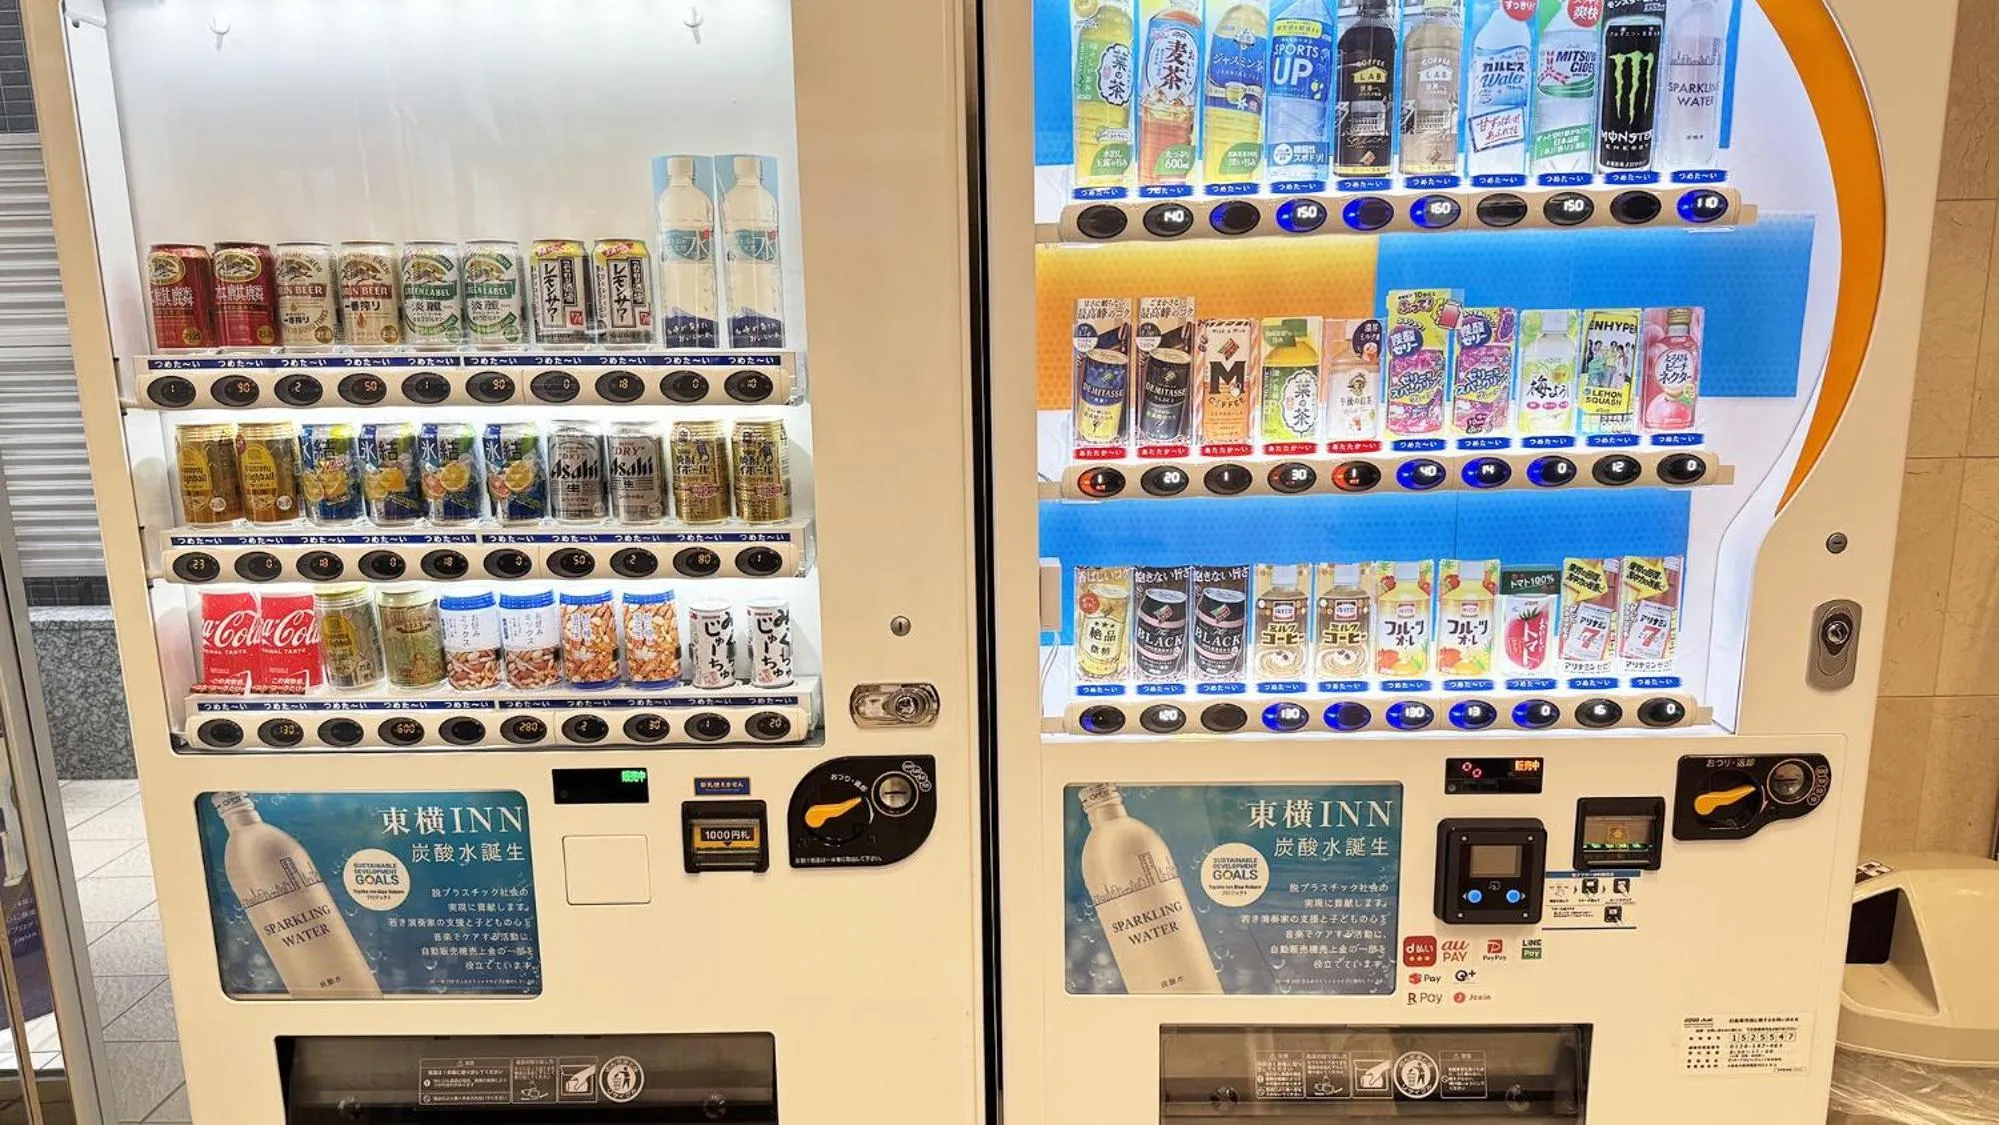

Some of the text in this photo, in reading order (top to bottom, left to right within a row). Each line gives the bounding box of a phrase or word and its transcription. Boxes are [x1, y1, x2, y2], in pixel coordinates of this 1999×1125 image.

[1573, 6, 1598, 20] 爽快
[1274, 43, 1319, 58] SPORTS
[1160, 40, 1187, 90] 麦茶
[1213, 53, 1264, 72] ジャスミン茶
[1482, 62, 1525, 73] カルピス
[1108, 50, 1127, 99] 葉の茶
[1273, 57, 1313, 86] UP
[1360, 72, 1382, 80] LAB
[1480, 72, 1525, 88] Water
[1164, 211, 1183, 222] 140
[363, 287, 388, 295] BEER
[544, 264, 560, 322] レモンサワー
[613, 264, 630, 322] レモンサワー
[345, 301, 381, 312] 一番搾り
[471, 300, 499, 310] 淡麗
[1078, 307, 1129, 319] 最高峰のコク
[1141, 307, 1193, 319] 最高峰のコク
[1666, 362, 1687, 372] ピーチ
[1210, 361, 1246, 394] M
[1659, 372, 1692, 384] ネクター
[365, 381, 377, 391] 50
[1083, 383, 1123, 398] DEMITASSE
[1145, 383, 1186, 397] DEMITASSE
[1592, 389, 1622, 398] LEMON
[1293, 379, 1310, 426] 葉の茶
[1585, 397, 1621, 406] SQUASH
[361, 439, 398, 462] 氷結
[421, 439, 460, 461] 氷結
[486, 439, 522, 461] 氷結
[551, 459, 598, 479] Asahi
[610, 456, 653, 476] Asahi
[1558, 463, 1566, 474] 0
[1687, 461, 1695, 470] 0
[1164, 472, 1180, 483] 20
[1292, 470, 1306, 480] 30
[566, 484, 580, 492] 生
[1510, 575, 1554, 589] トマト100%
[1089, 626, 1116, 641] 絶品
[1269, 624, 1296, 633] ミルク
[1331, 623, 1357, 631] ミルク
[1385, 621, 1424, 635] フルーツ
[1447, 620, 1488, 634] フルーツ
[1138, 626, 1183, 647] BLACK
[1195, 627, 1241, 647] BLACK
[1262, 633, 1305, 645] コーヒー
[1324, 632, 1367, 644] コーヒー
[1583, 627, 1600, 648] 7
[1642, 626, 1661, 647] 7
[705, 620, 730, 679] じゅーちゅ
[758, 617, 783, 677] じゅーちゅ
[1281, 708, 1300, 719] 130
[1541, 705, 1550, 715] 0
[1667, 704, 1675, 714] 0
[1515, 760, 1540, 772] 販売中
[1706, 758, 1755, 767] おつり・返却
[381, 806, 523, 835] 東横INN
[1247, 799, 1392, 829] 東横INN
[705, 830, 750, 840] 1000円札
[411, 843, 525, 863] 炭酸水誕生
[1274, 837, 1389, 857] 炭酸水誕生
[355, 875, 399, 885] GOALS
[1213, 869, 1258, 881] GOALS
[263, 904, 331, 936] SPARKLING
[1112, 901, 1183, 934] SPARKLING
[281, 924, 329, 948] WATER
[1127, 922, 1180, 946] WATER
[1406, 943, 1434, 953] d払い
[1441, 940, 1469, 951] au
[1443, 952, 1468, 962] PAY
[1524, 949, 1540, 958] Pay
[1424, 974, 1441, 983] Pay
[1407, 992, 1442, 1005] R Pay
